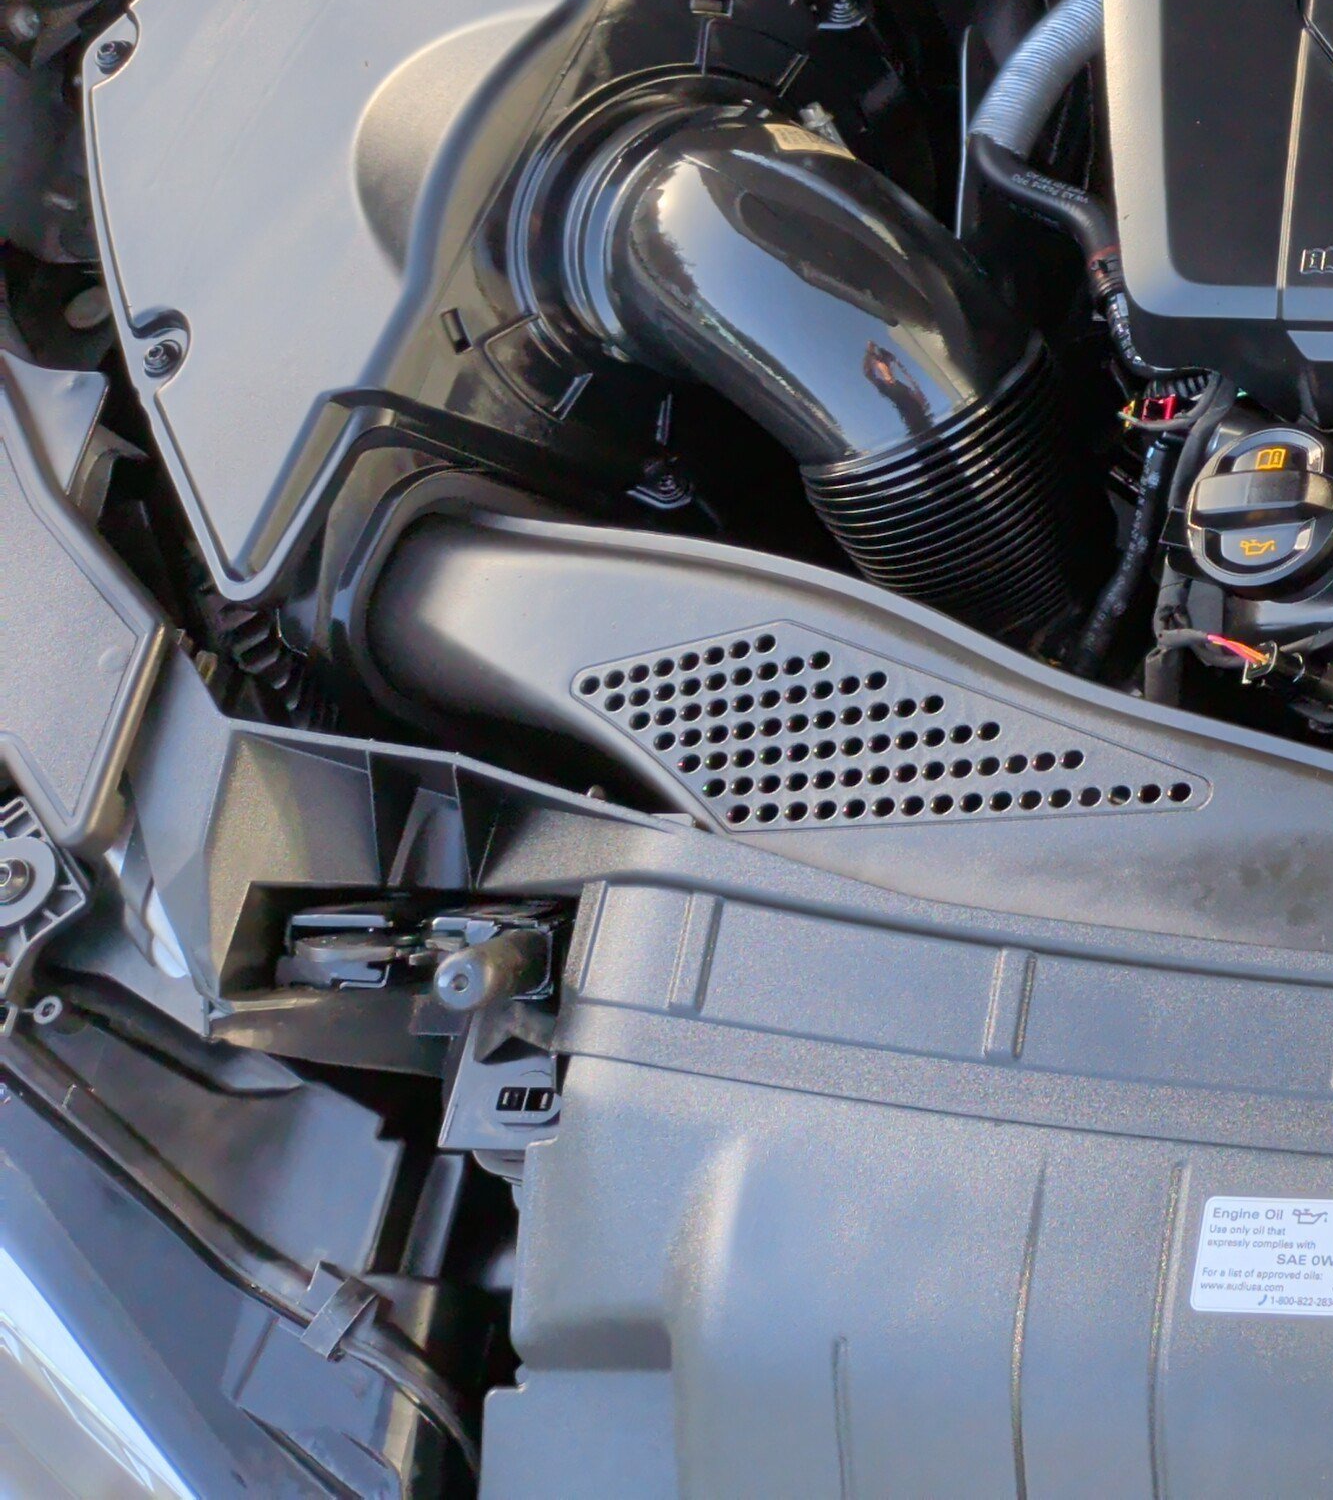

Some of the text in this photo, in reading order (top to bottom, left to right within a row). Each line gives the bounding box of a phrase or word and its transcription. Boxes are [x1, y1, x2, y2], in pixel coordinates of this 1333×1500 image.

[1213, 1208, 1283, 1221] Engine Oil
[1209, 1225, 1285, 1236] Use only oil that
[1208, 1240, 1315, 1249] expressly complies with
[1276, 1254, 1306, 1265] SAE
[1202, 1267, 1217, 1276] For
[1228, 1268, 1241, 1277] list
[1244, 1269, 1255, 1277] of
[1257, 1270, 1300, 1280] approved
[1201, 1281, 1284, 1292] www.audiusa.com
